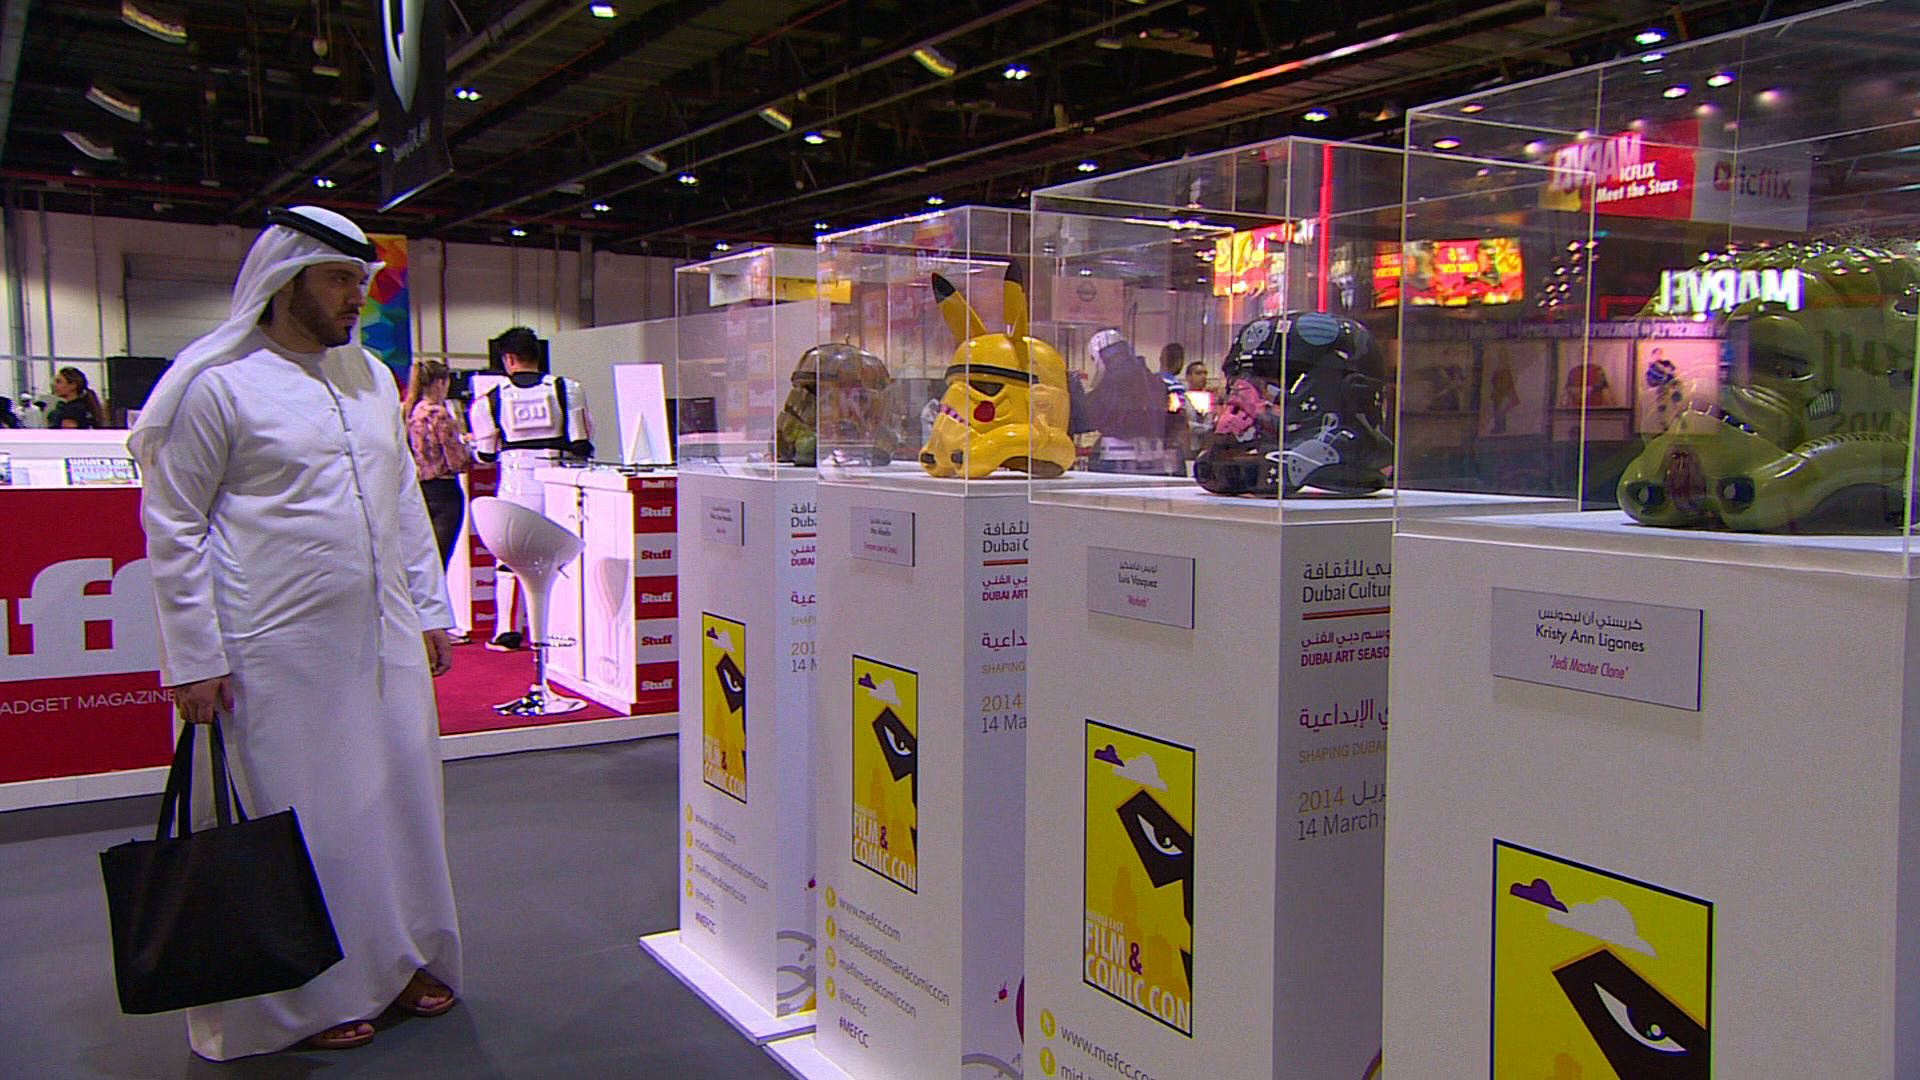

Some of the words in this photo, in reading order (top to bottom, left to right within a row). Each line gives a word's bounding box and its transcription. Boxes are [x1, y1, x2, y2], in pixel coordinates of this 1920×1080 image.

[1597, 185, 1625, 202] Meet
[1627, 182, 1646, 198] the
[1648, 179, 1678, 196] Stars
[1740, 166, 1791, 200] icflix
[640, 506, 672, 517] Stuff
[791, 516, 816, 528] Dub
[641, 549, 672, 560] Stuff
[983, 538, 1020, 553] Dubai
[1303, 559, 1364, 581] للثقافة
[641, 592, 673, 603] Stuff
[982, 590, 1010, 601] DUBAI
[1303, 584, 1345, 603] Dubai
[641, 635, 673, 647] Stuff
[1336, 630, 1360, 648] دبي
[1535, 624, 1567, 645] Kristy
[1570, 629, 1595, 645] Ann
[1598, 633, 1645, 652] Ligones
[791, 658, 806, 673] 14
[1301, 651, 1332, 667] DUBAI
[1335, 649, 1356, 664] ART
[1569, 656, 1599, 675] Master
[641, 678, 673, 690] Stuff
[78, 688, 174, 709] MAGAZINE
[982, 692, 1023, 713] 2014
[982, 715, 999, 734] 14
[1299, 698, 1375, 732] الإبداعية
[1299, 743, 1350, 764] SHAPING
[1298, 786, 1346, 813] 2014
[854, 812, 879, 846] FILM
[880, 825, 889, 852] &
[1297, 817, 1318, 841] 14
[1323, 809, 1379, 836] March
[854, 838, 890, 875] COMIC
[890, 857, 917, 891] CON
[839, 896, 902, 942] www.mefcc.com
[1085, 919, 1127, 969] FILM
[1129, 942, 1143, 975] &
[839, 987, 868, 1018] @mefcc
[1085, 953, 1146, 1008] COMIC
[1149, 985, 1190, 1033] CON
[839, 1016, 870, 1049] #MEFCC
[1061, 1026, 1158, 1080] www.mefcc.co
